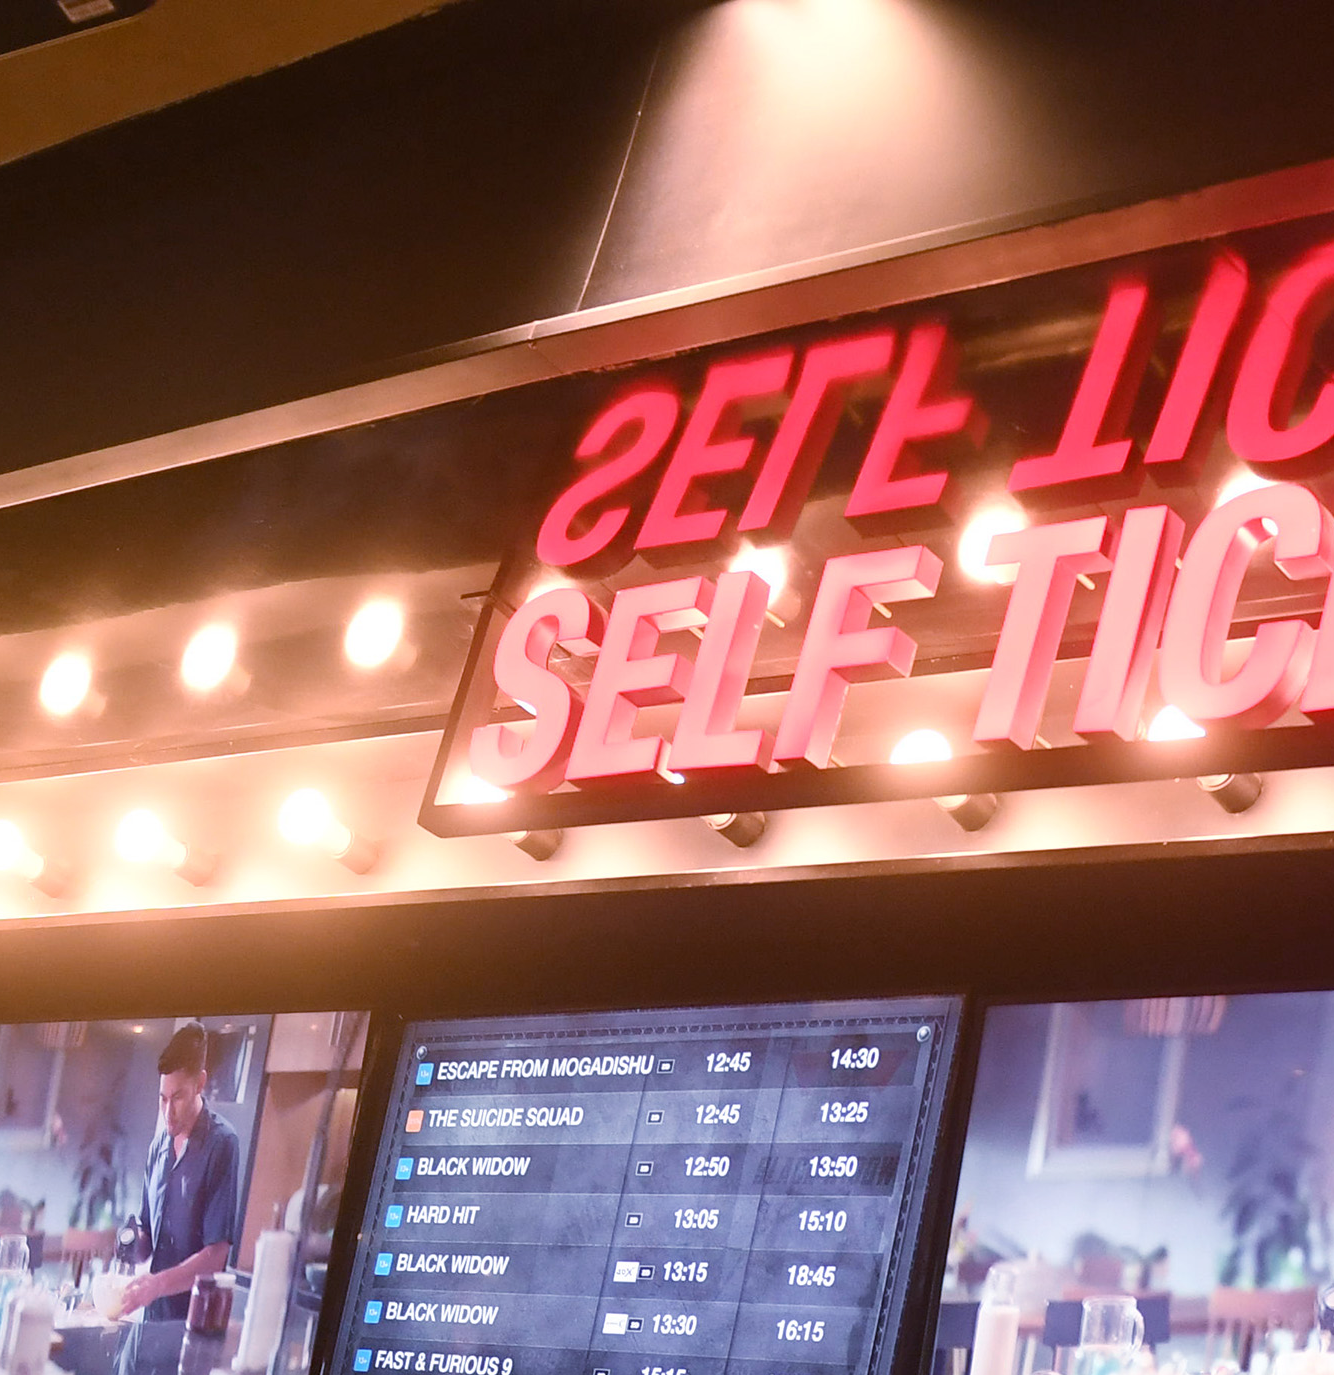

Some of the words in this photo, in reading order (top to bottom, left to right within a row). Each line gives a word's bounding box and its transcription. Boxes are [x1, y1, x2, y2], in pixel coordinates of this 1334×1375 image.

[469, 545, 944, 790] SELF
[436, 1061, 498, 1081] ESCAPE
[500, 1058, 549, 1078] FROM
[550, 1054, 655, 1077] MOGADISHU
[706, 1052, 752, 1073] 12:45
[830, 1047, 880, 1069] 14:30
[428, 1109, 459, 1128] THE
[459, 1107, 524, 1128] SUICIDE
[525, 1106, 585, 1127] SQUAD
[695, 1104, 741, 1125] 12:45
[819, 1101, 869, 1123] 13:25
[417, 1157, 471, 1176] BLACK
[471, 1156, 531, 1176] WIDOW
[684, 1156, 730, 1177] 12:50
[808, 1156, 859, 1177] 13:50
[406, 1205, 451, 1225] HARD
[452, 1206, 481, 1225] HIT
[673, 1208, 720, 1230] 13:05
[798, 1210, 848, 1232] 15:10
[396, 1253, 449, 1274] BLACK
[450, 1255, 510, 1276] WIDOW
[662, 1261, 709, 1283] 13:15
[786, 1264, 837, 1287] 18:45
[385, 1301, 439, 1322] BLACK
[439, 1303, 499, 1325] WIDOW
[652, 1313, 698, 1336] 13:30
[775, 1319, 826, 1342] 16:15
[374, 1350, 415, 1371] FAST
[415, 1352, 427, 1372] &
